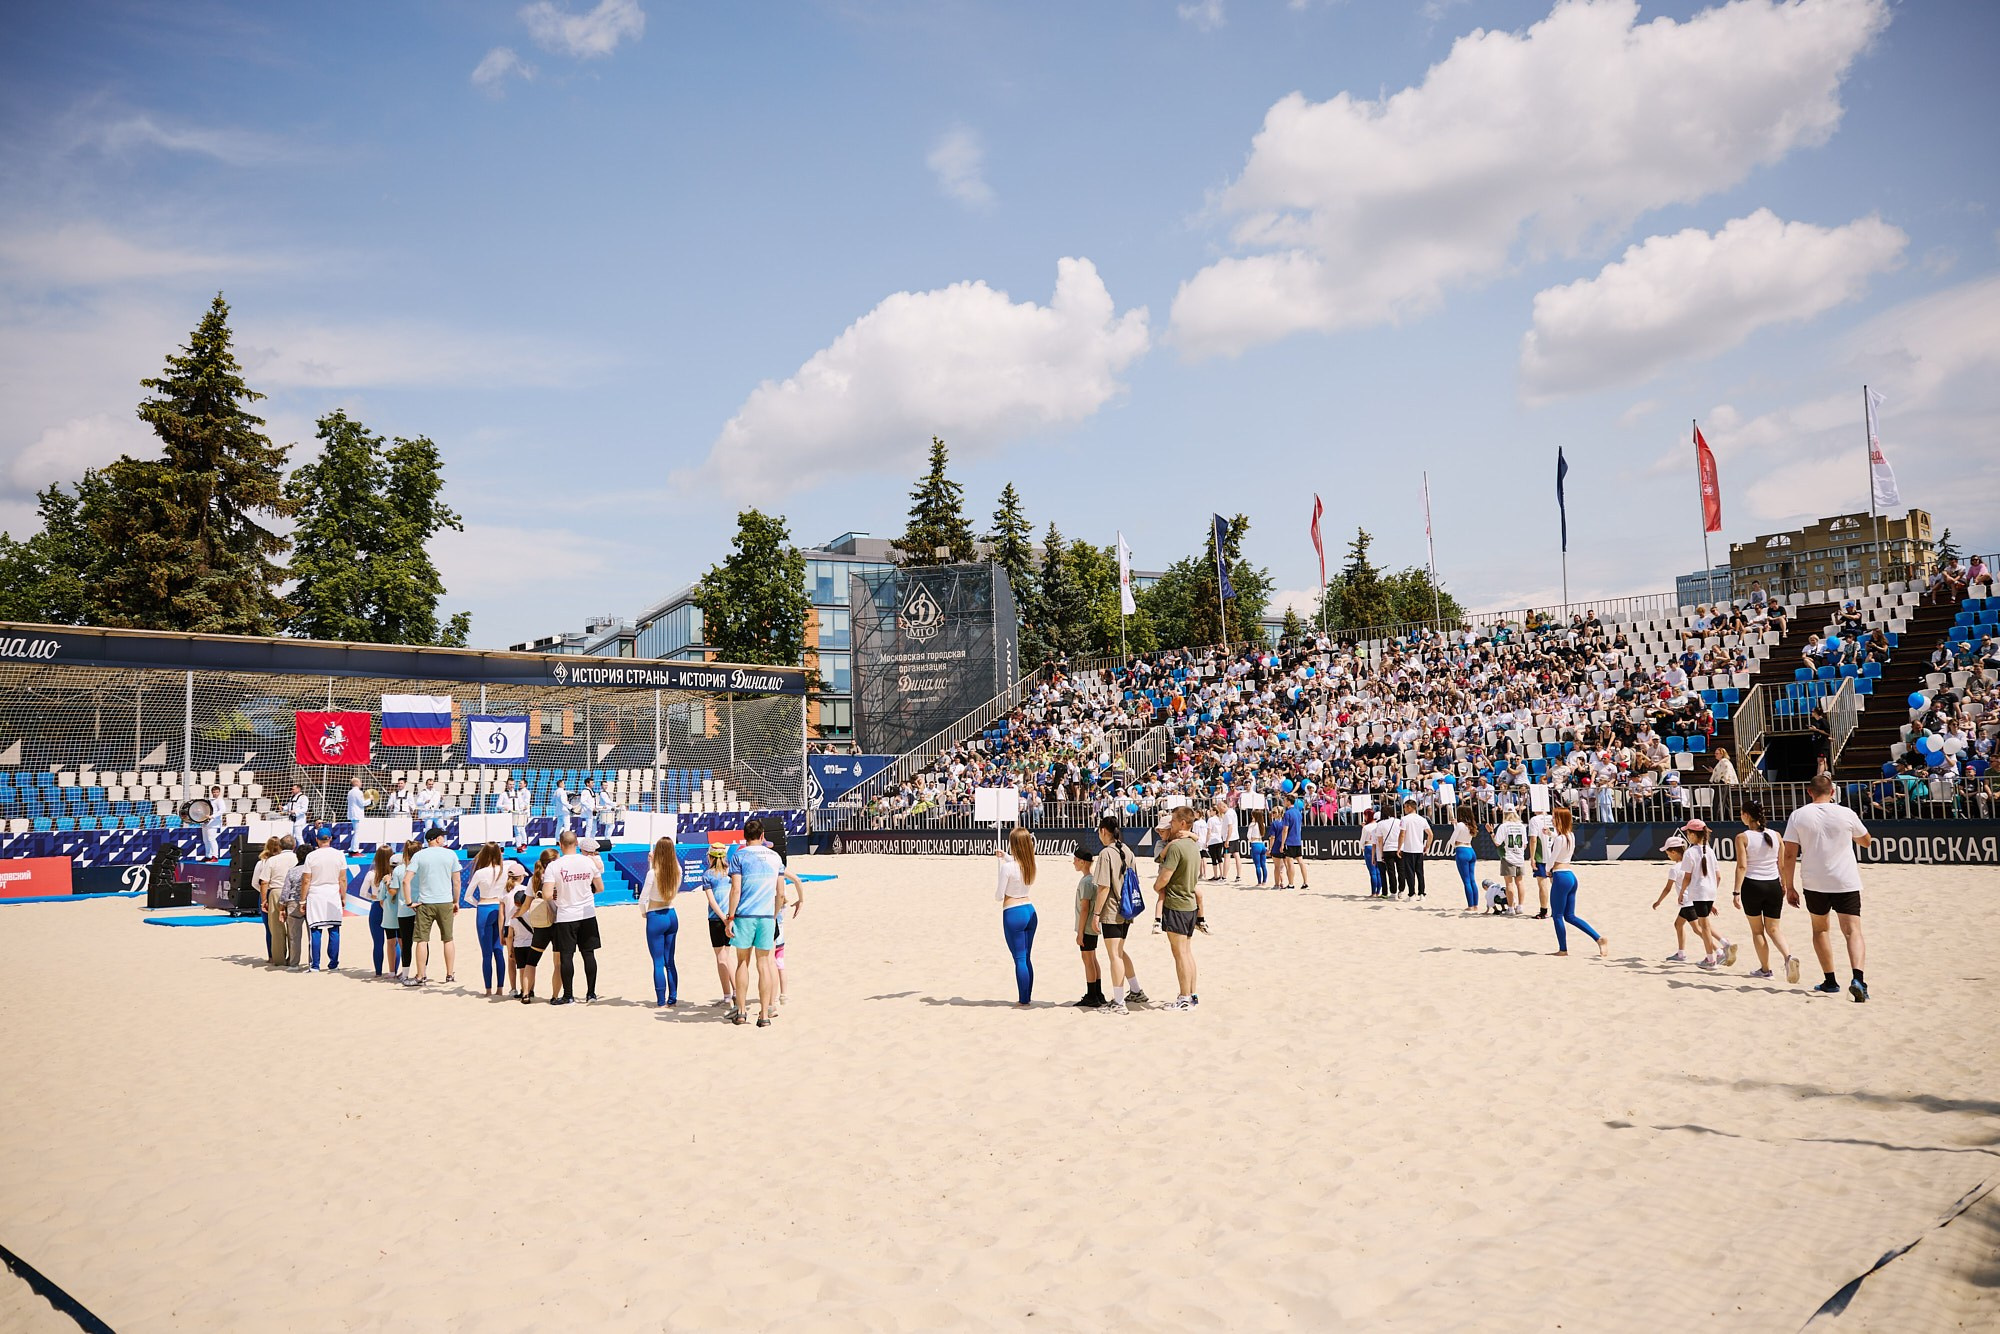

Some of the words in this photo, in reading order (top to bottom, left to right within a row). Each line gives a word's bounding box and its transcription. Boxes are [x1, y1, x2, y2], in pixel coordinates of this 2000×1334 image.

[880, 652, 925, 662] Московская
[927, 650, 966, 661] городская
[899, 663, 947, 674] организация
[571, 667, 624, 684] ИСТОРИЯ
[626, 669, 669, 685] СТРАНЫ
[679, 671, 726, 688] ИСТОРИЯ
[730, 669, 784, 691] Динамо
[897, 675, 949, 692] Динамо
[845, 840, 900, 854] МОСКОВСКАЯ
[901, 840, 950, 854] ГОРОДСКАЯ
[1507, 834, 1523, 848] 14
